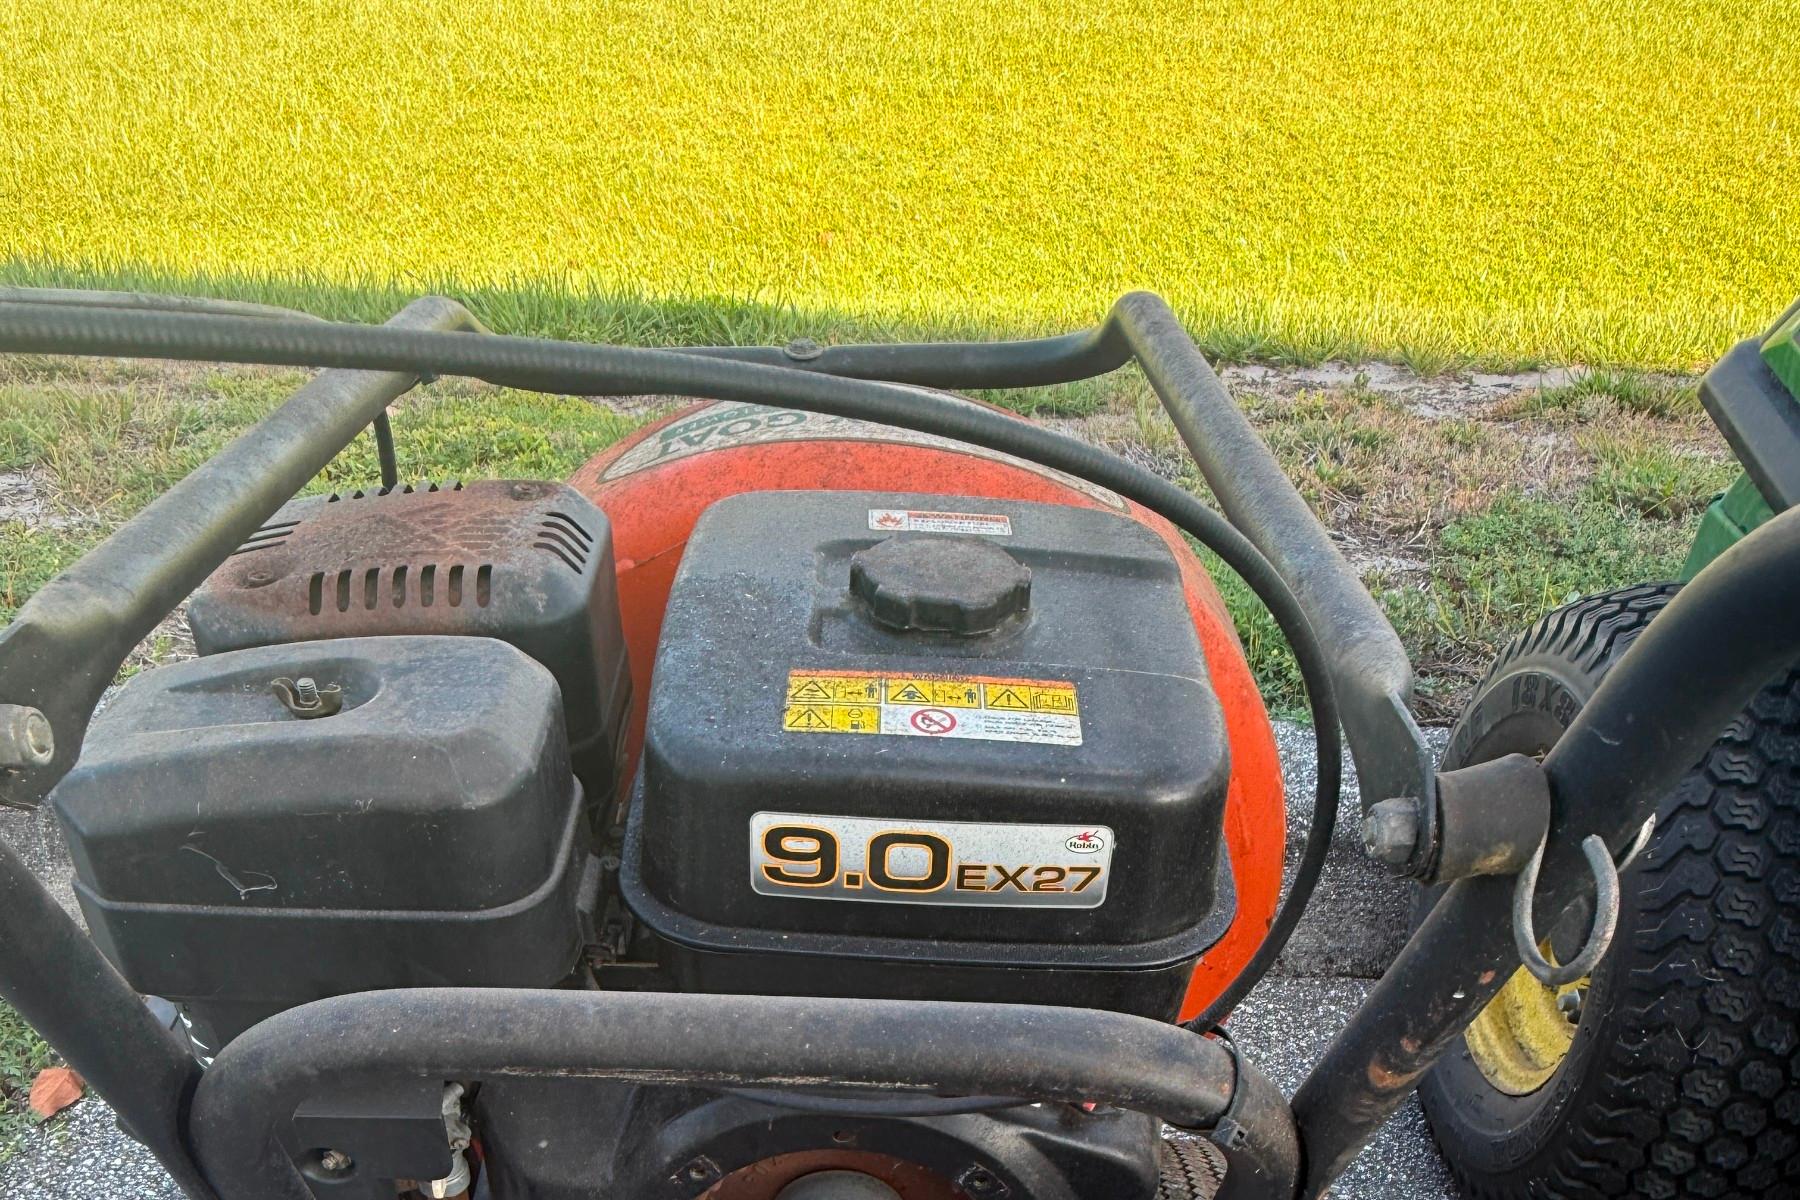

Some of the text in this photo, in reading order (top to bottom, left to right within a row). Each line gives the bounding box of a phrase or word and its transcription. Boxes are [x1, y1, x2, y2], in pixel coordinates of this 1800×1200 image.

[657, 411, 808, 459] GOAT
[762, 825, 1102, 894] 9.0 EX27
